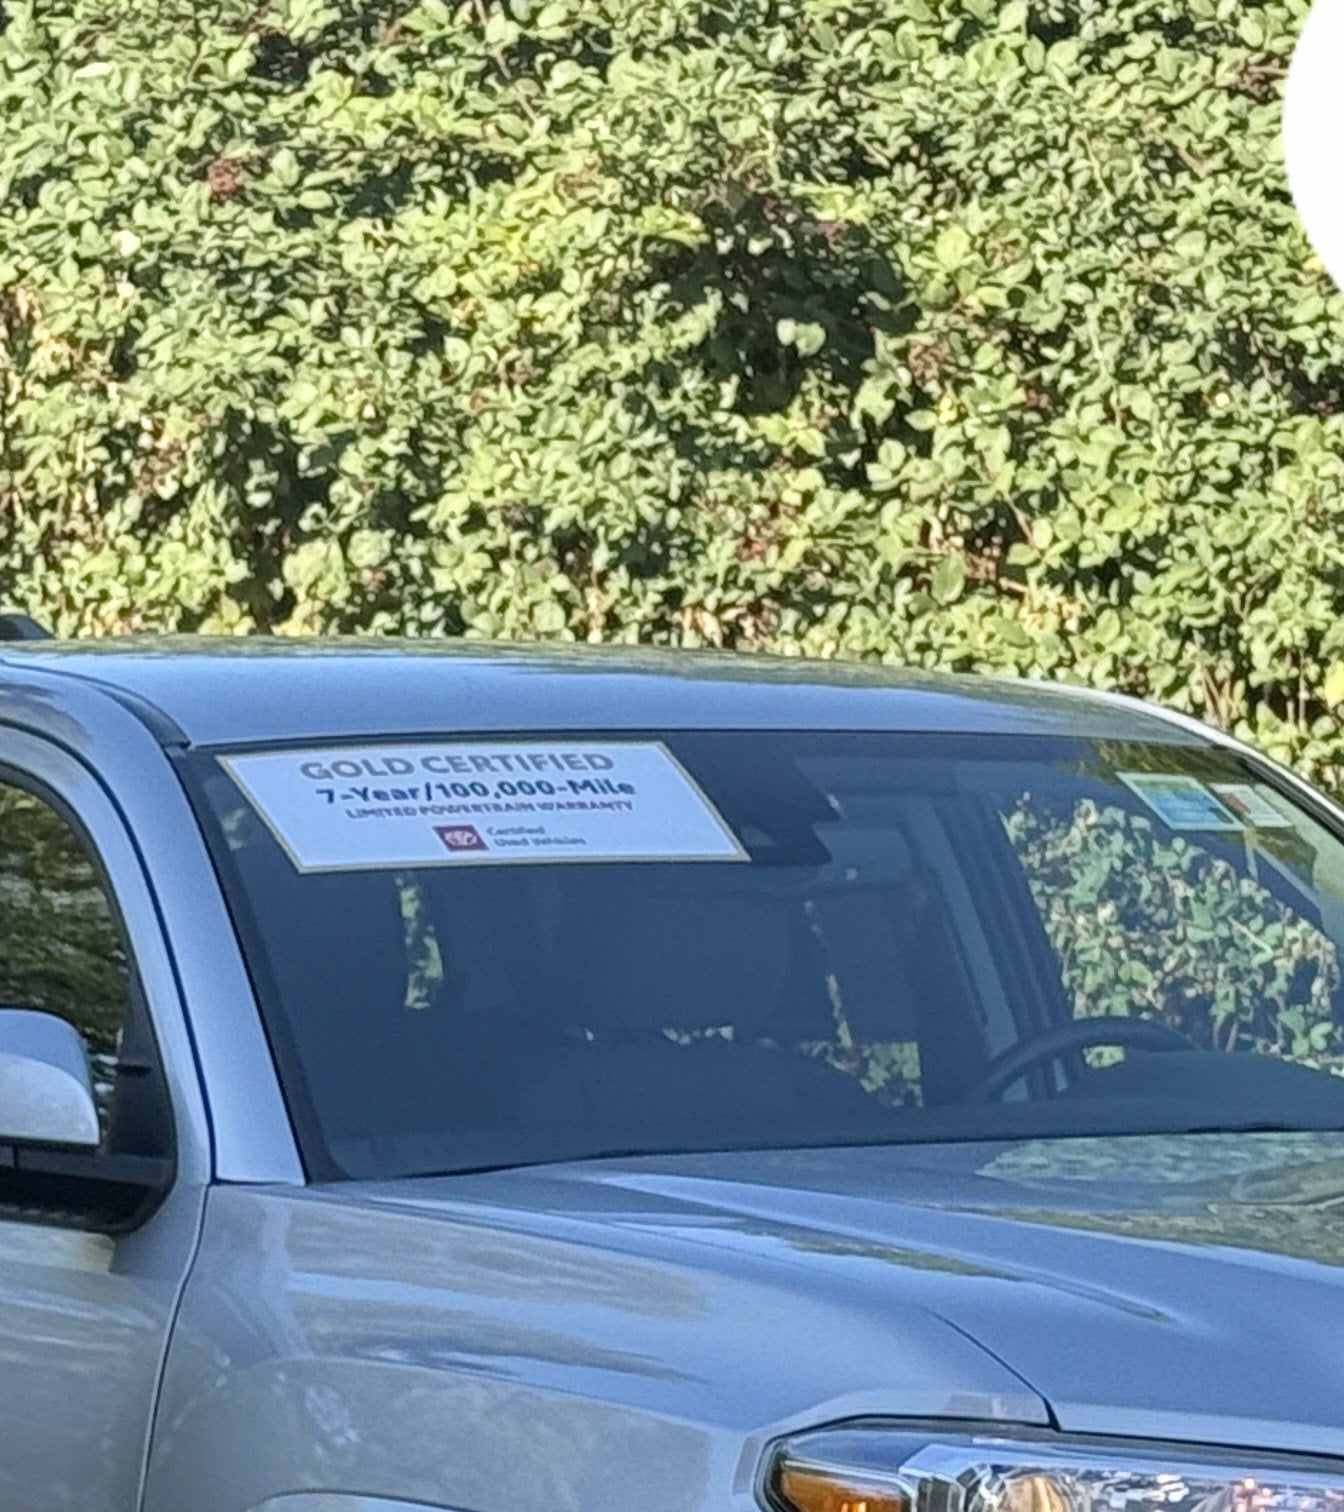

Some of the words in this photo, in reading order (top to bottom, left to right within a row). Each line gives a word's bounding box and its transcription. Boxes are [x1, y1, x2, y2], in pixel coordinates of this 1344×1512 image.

[299, 756, 416, 780] GOLD
[420, 753, 616, 774] CERTIFIED
[315, 778, 637, 804] 7-Year/100,000-Mile
